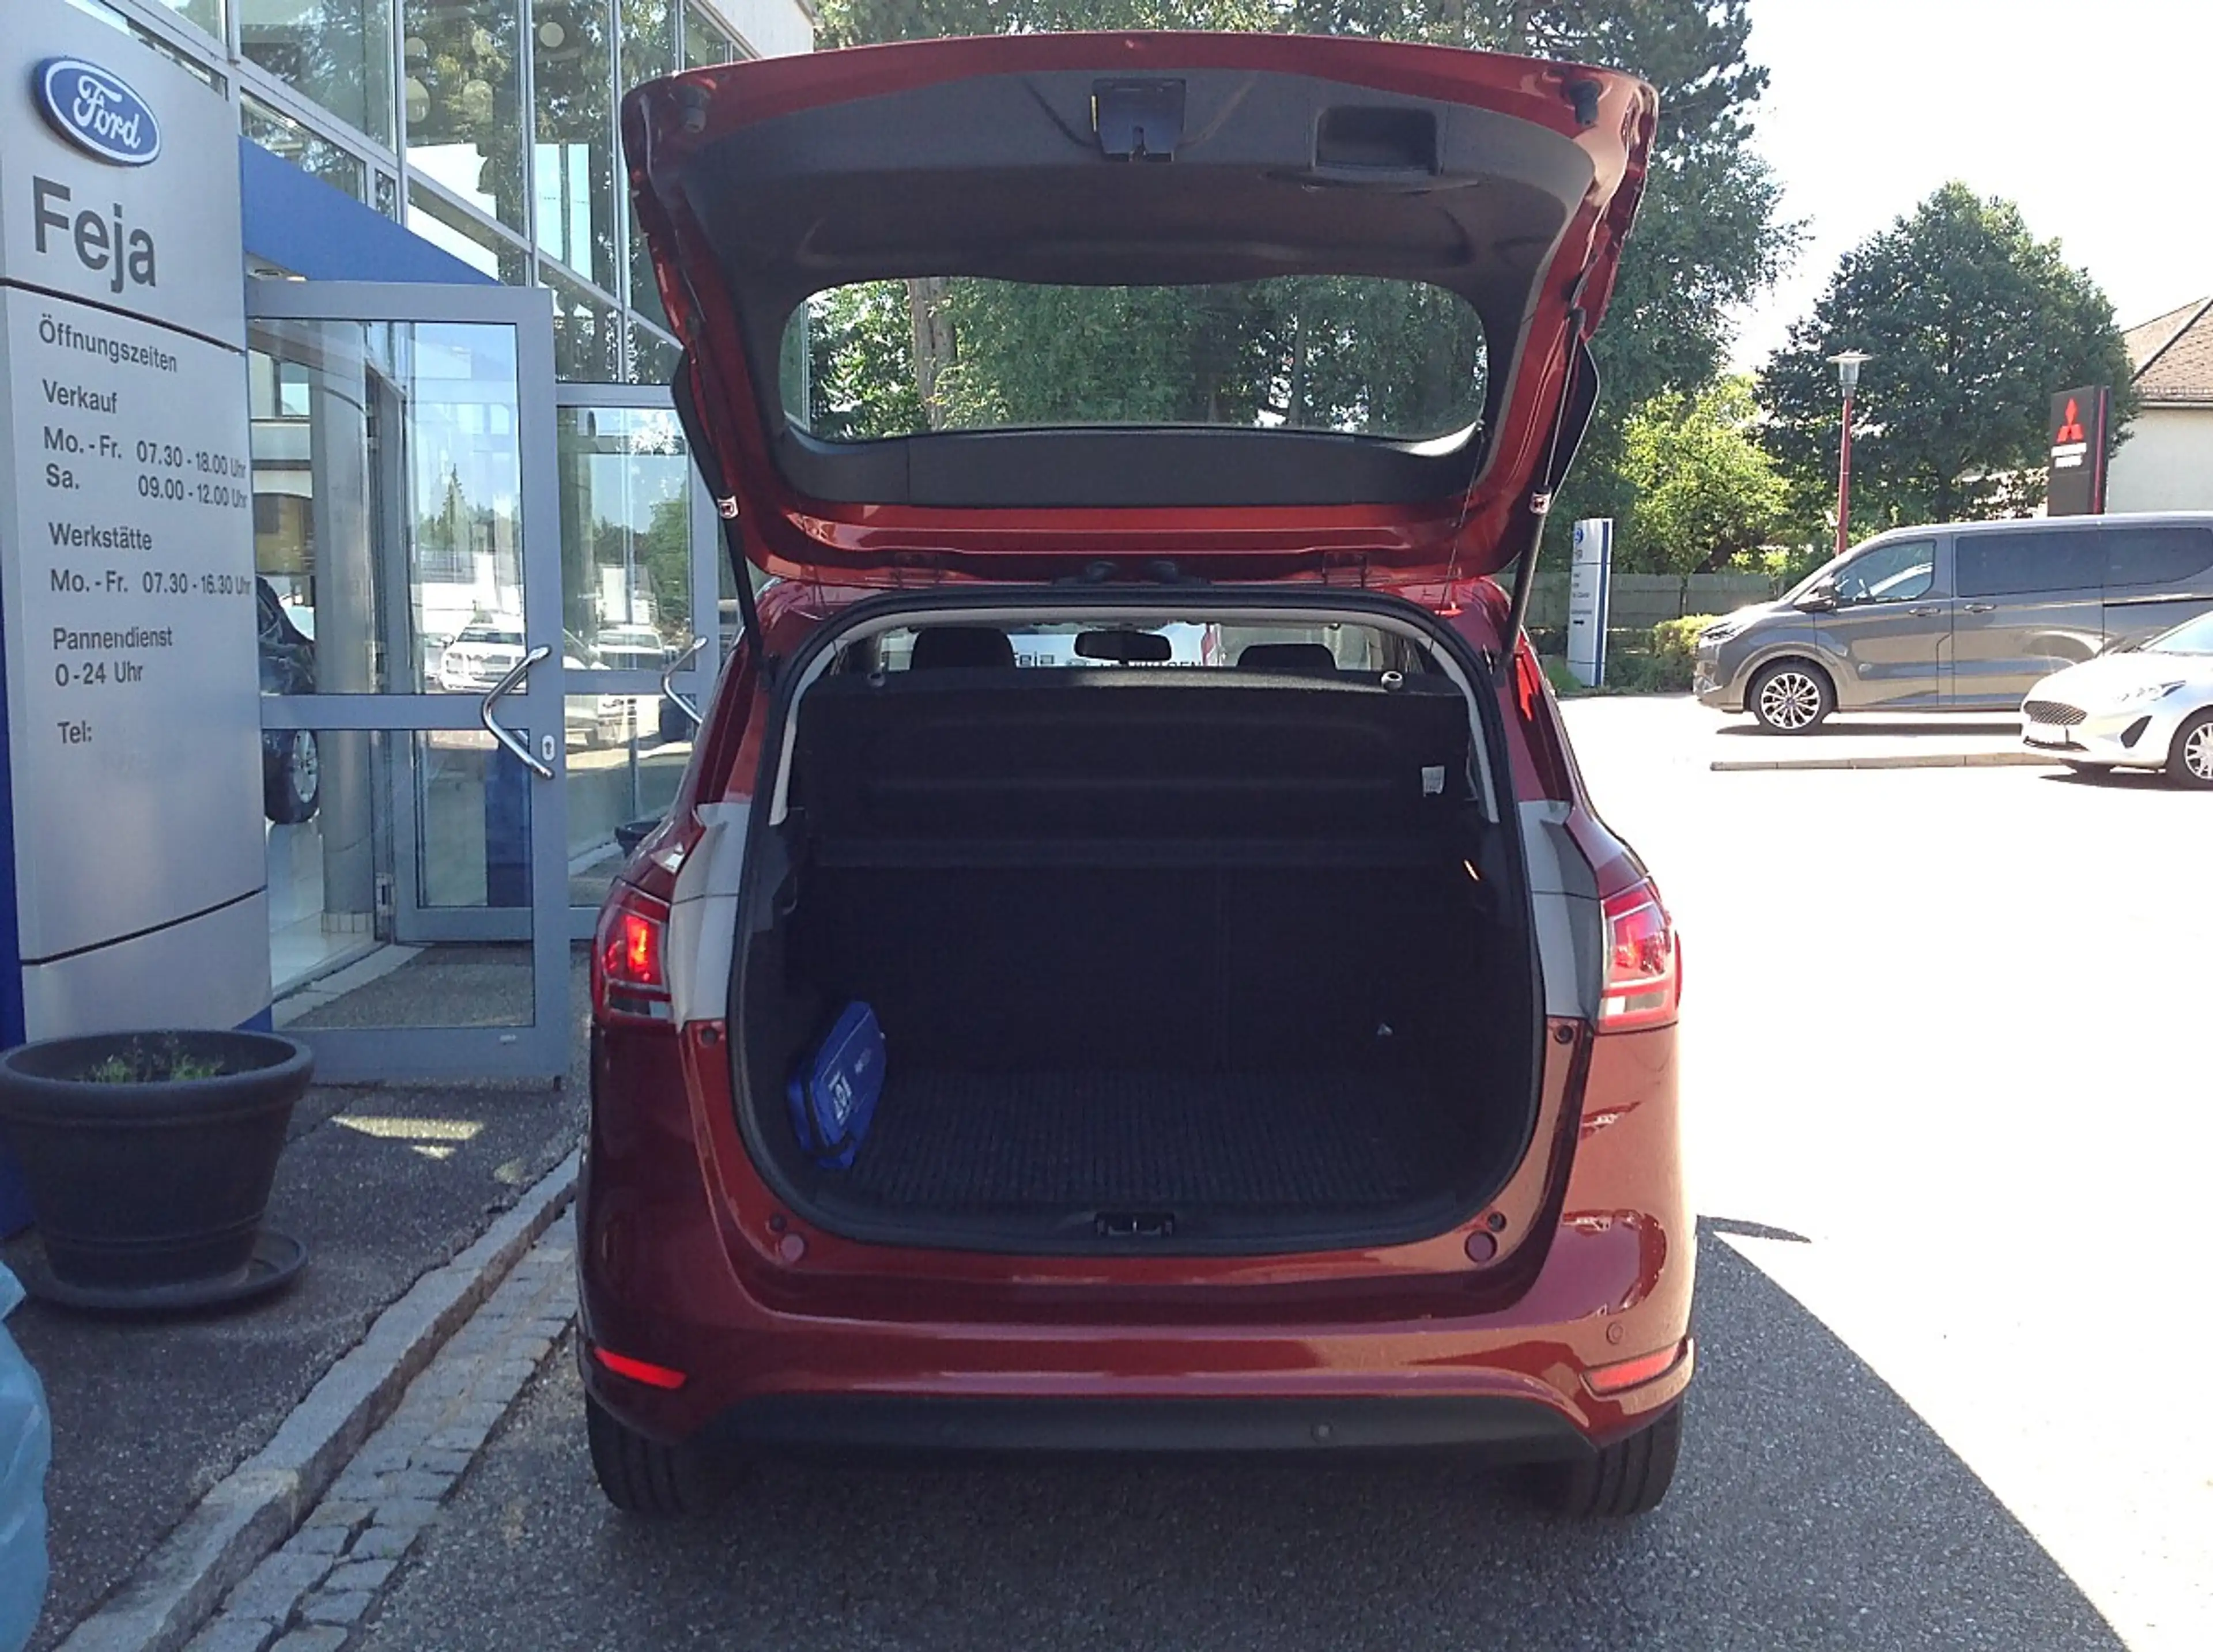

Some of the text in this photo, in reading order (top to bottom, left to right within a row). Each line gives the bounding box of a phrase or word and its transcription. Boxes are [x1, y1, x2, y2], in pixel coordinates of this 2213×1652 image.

[73, 75, 142, 149] Ford
[33, 175, 156, 294] Feja
[39, 313, 178, 373] Öffnungszeiten
[41, 378, 118, 414] Verkauf
[136, 440, 183, 468] 07.30
[195, 451, 228, 475] 18.00
[231, 458, 246, 478] Uhr
[46, 463, 80, 490] Sa.
[138, 474, 184, 501] 09.00
[197, 483, 229, 506] 12.00
[232, 488, 248, 508] Uhr
[48, 521, 152, 551] Werkstätte
[142, 571, 188, 594] 07.30
[201, 574, 232, 595] 16.30
[236, 576, 251, 595] Uhr
[53, 626, 173, 650] Pannendienst
[114, 660, 143, 683] Uhr
[57, 720, 92, 744] Tel:
